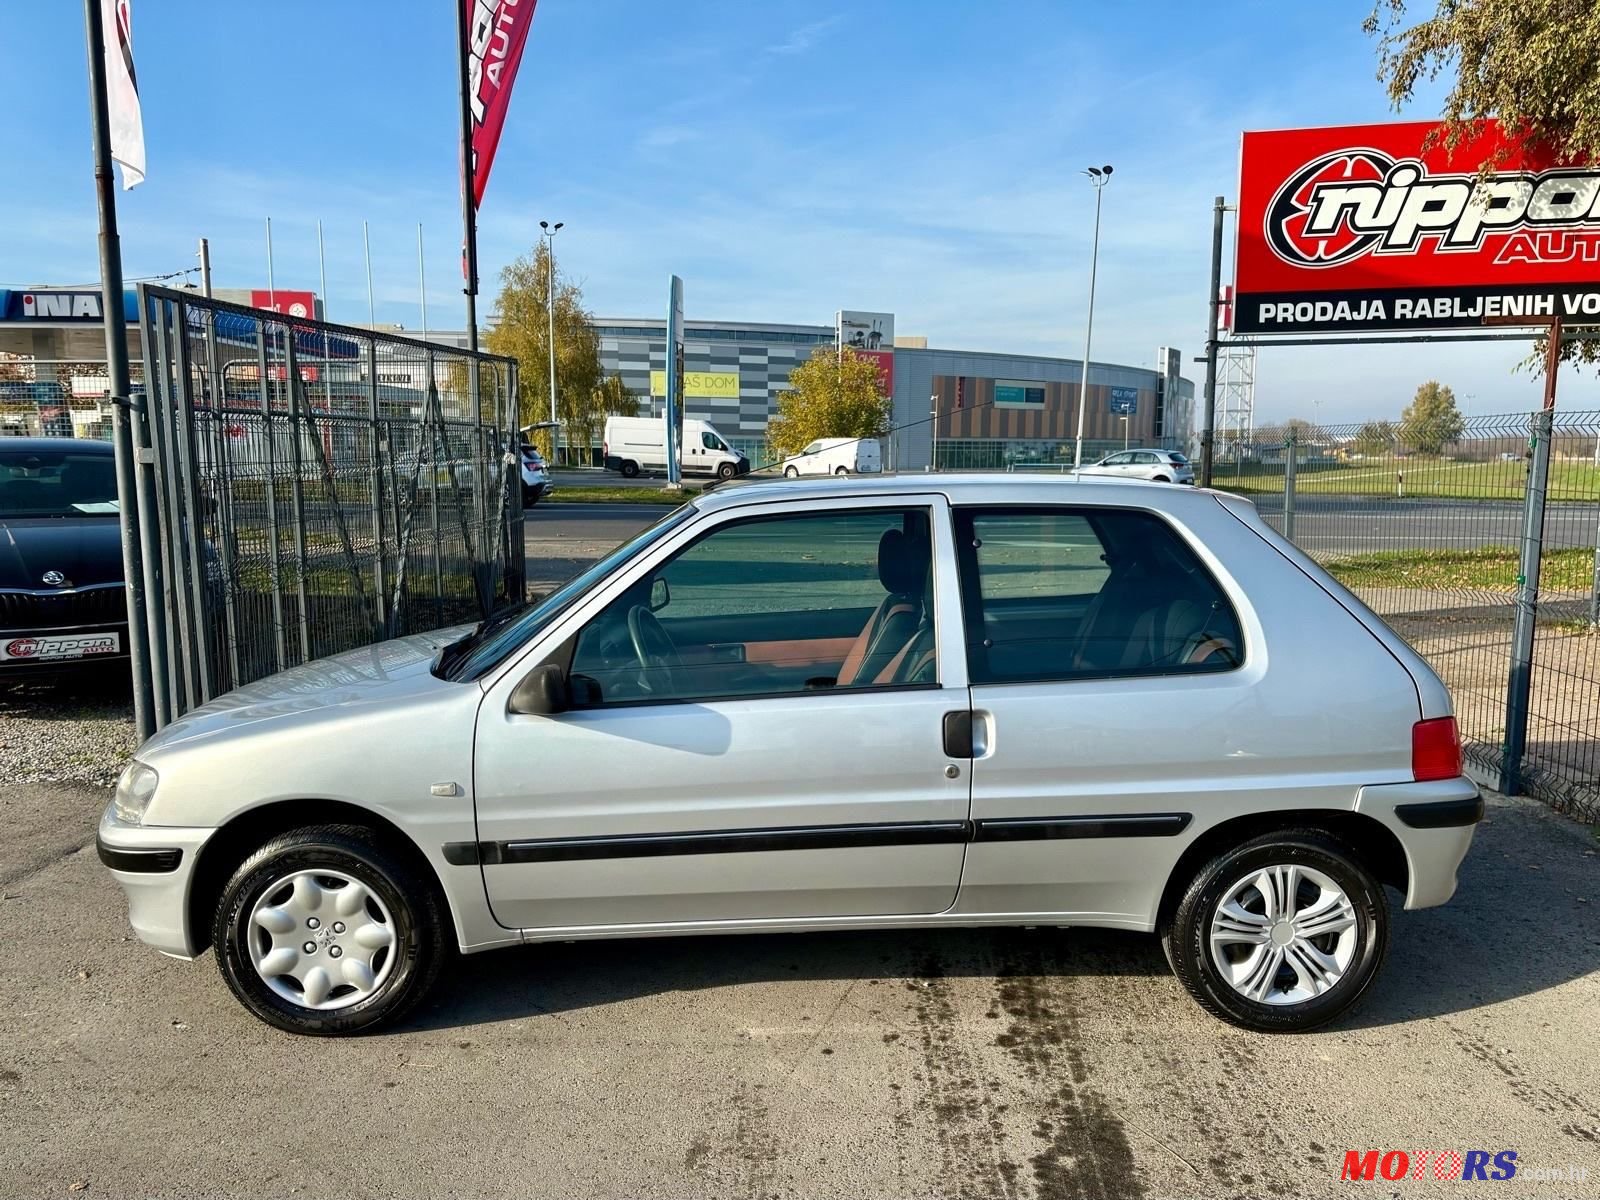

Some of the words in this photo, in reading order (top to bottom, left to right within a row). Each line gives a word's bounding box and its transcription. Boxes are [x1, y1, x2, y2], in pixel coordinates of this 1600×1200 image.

[487, 0, 519, 90] AUT
[1258, 299, 1387, 323] PRODAJA
[1394, 294, 1554, 319] RABLJENIH
[704, 376, 735, 389] DOM
[16, 637, 116, 655] nippon
[82, 646, 115, 654] AUTO
